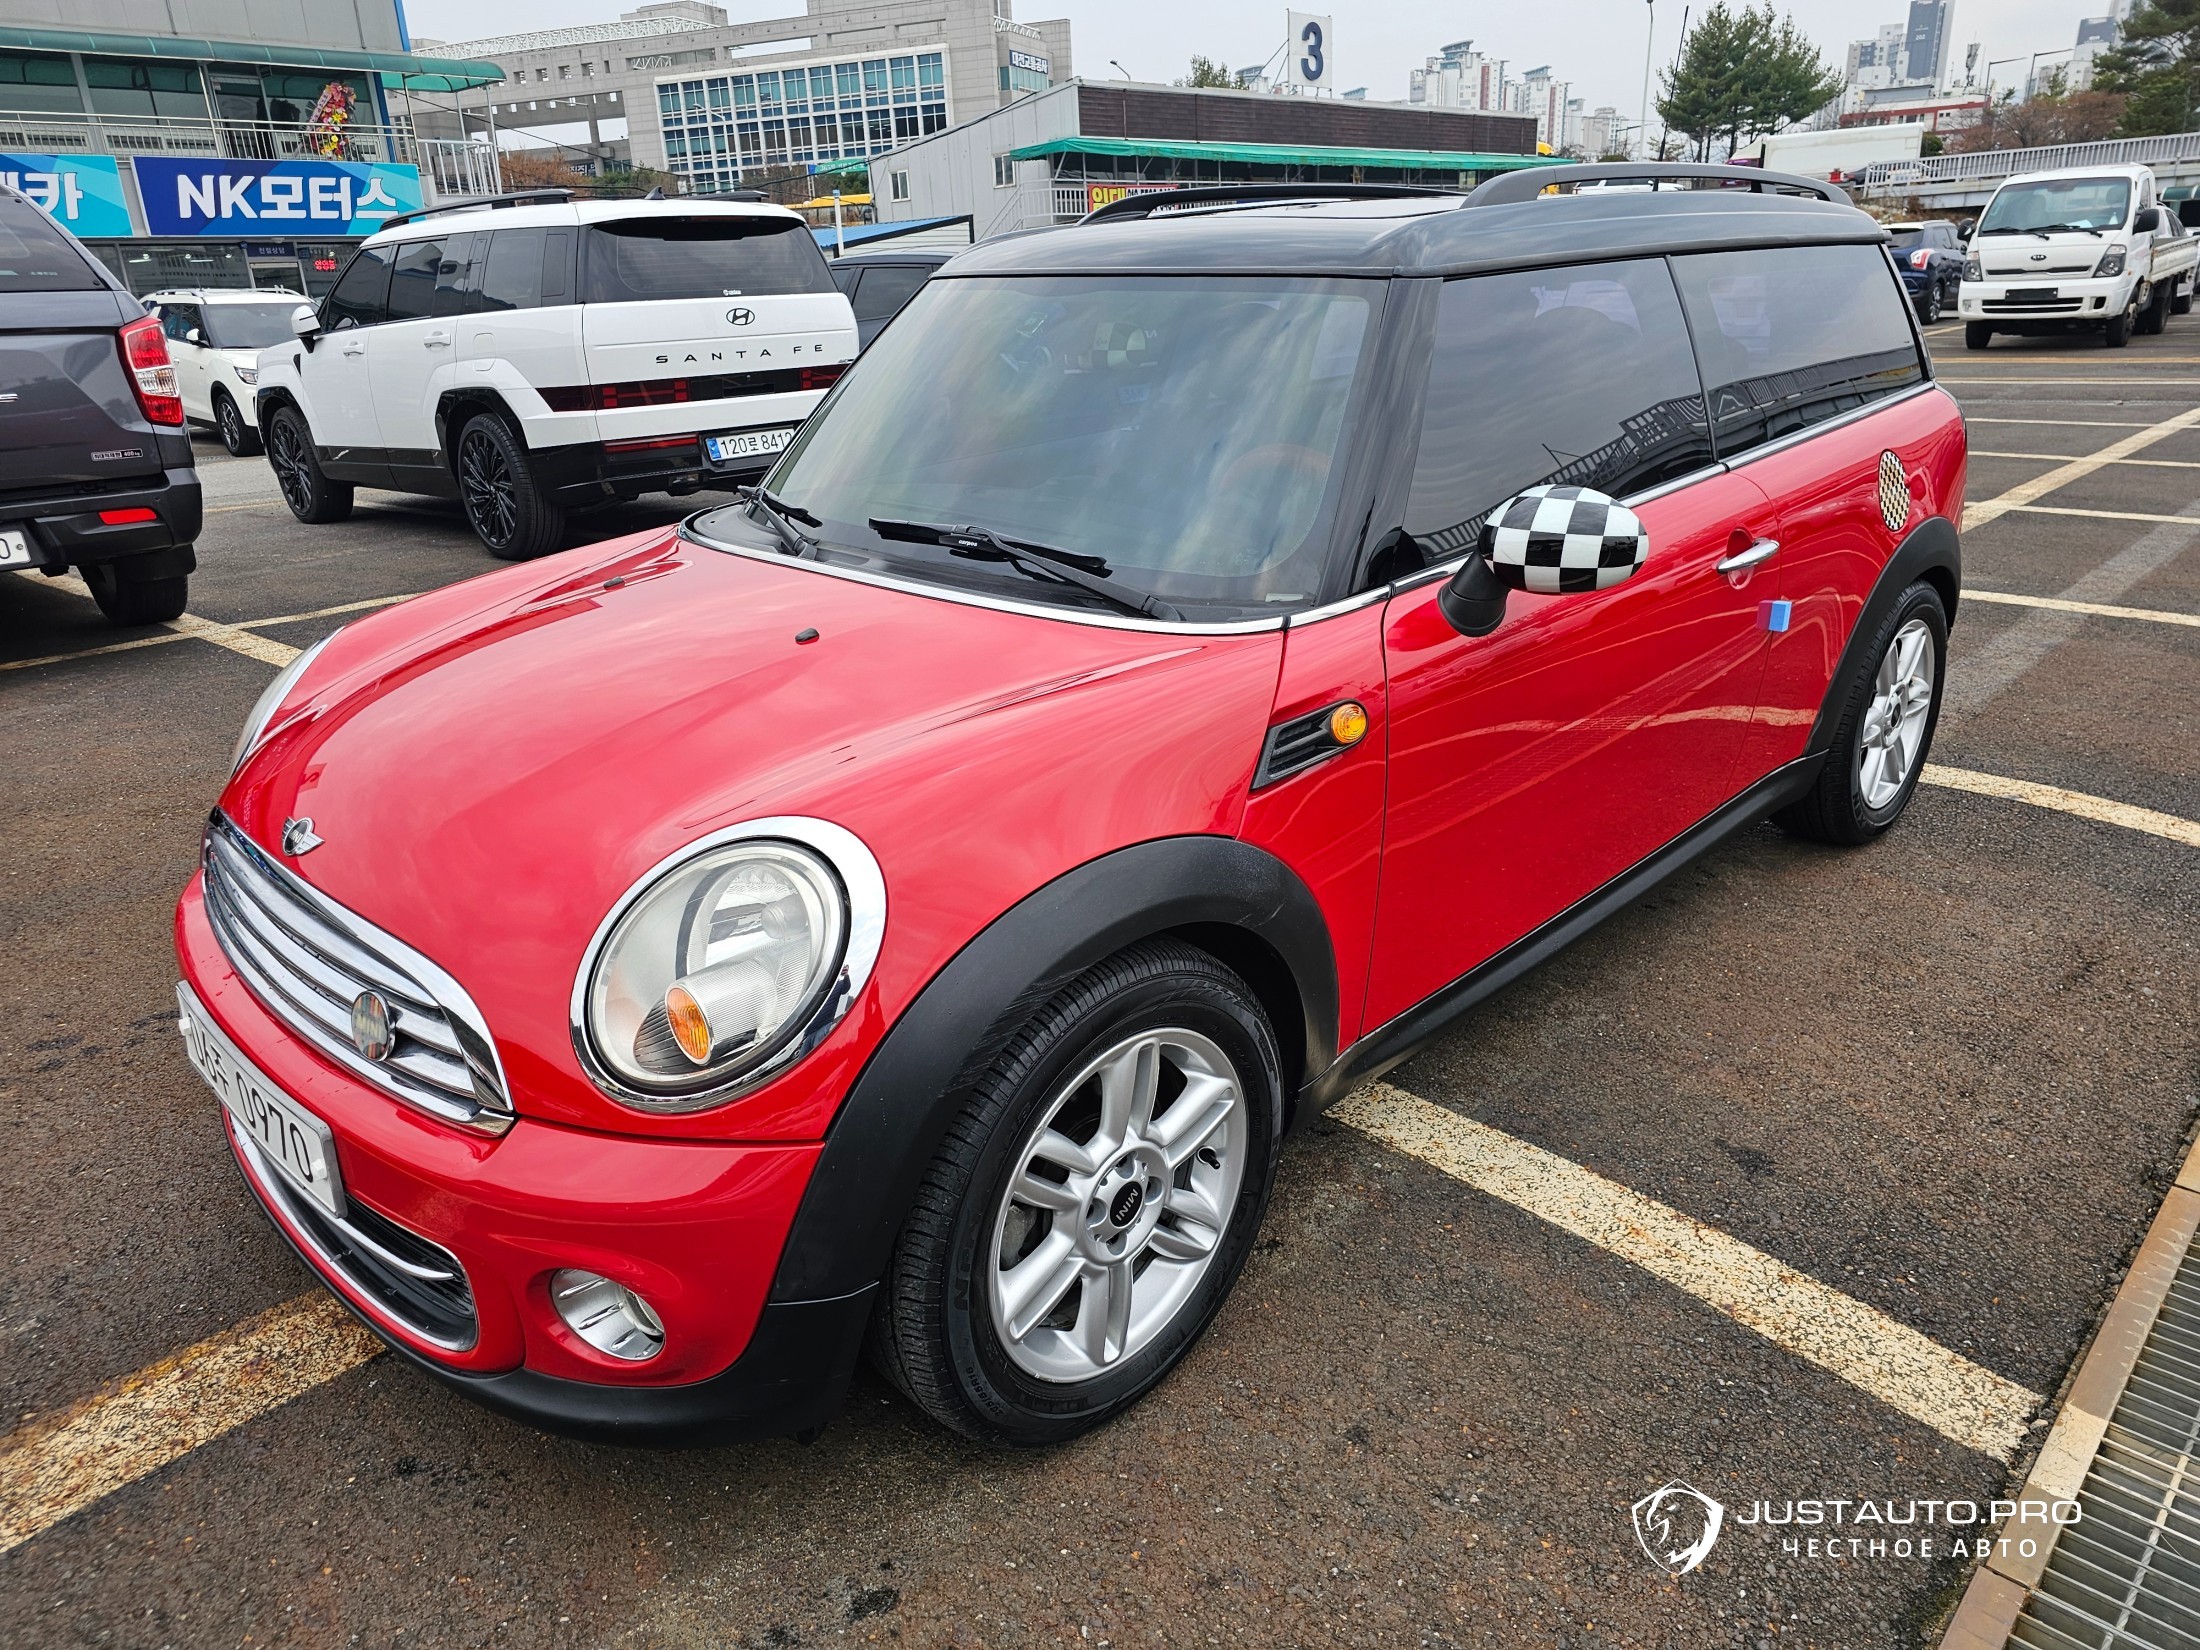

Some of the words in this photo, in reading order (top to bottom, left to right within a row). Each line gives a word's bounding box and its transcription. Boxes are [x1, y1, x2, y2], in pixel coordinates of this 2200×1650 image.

[1301, 21, 1324, 81] 3
[0, 171, 84, 220] 카
[177, 174, 399, 221] NK모터스
[655, 348, 772, 364] SANTA
[793, 344, 823, 354] FE
[721, 437, 759, 456] 120로
[356, 1013, 383, 1041] MINI
[236, 1070, 314, 1184] 0970
[1115, 1188, 1139, 1222] MINI
